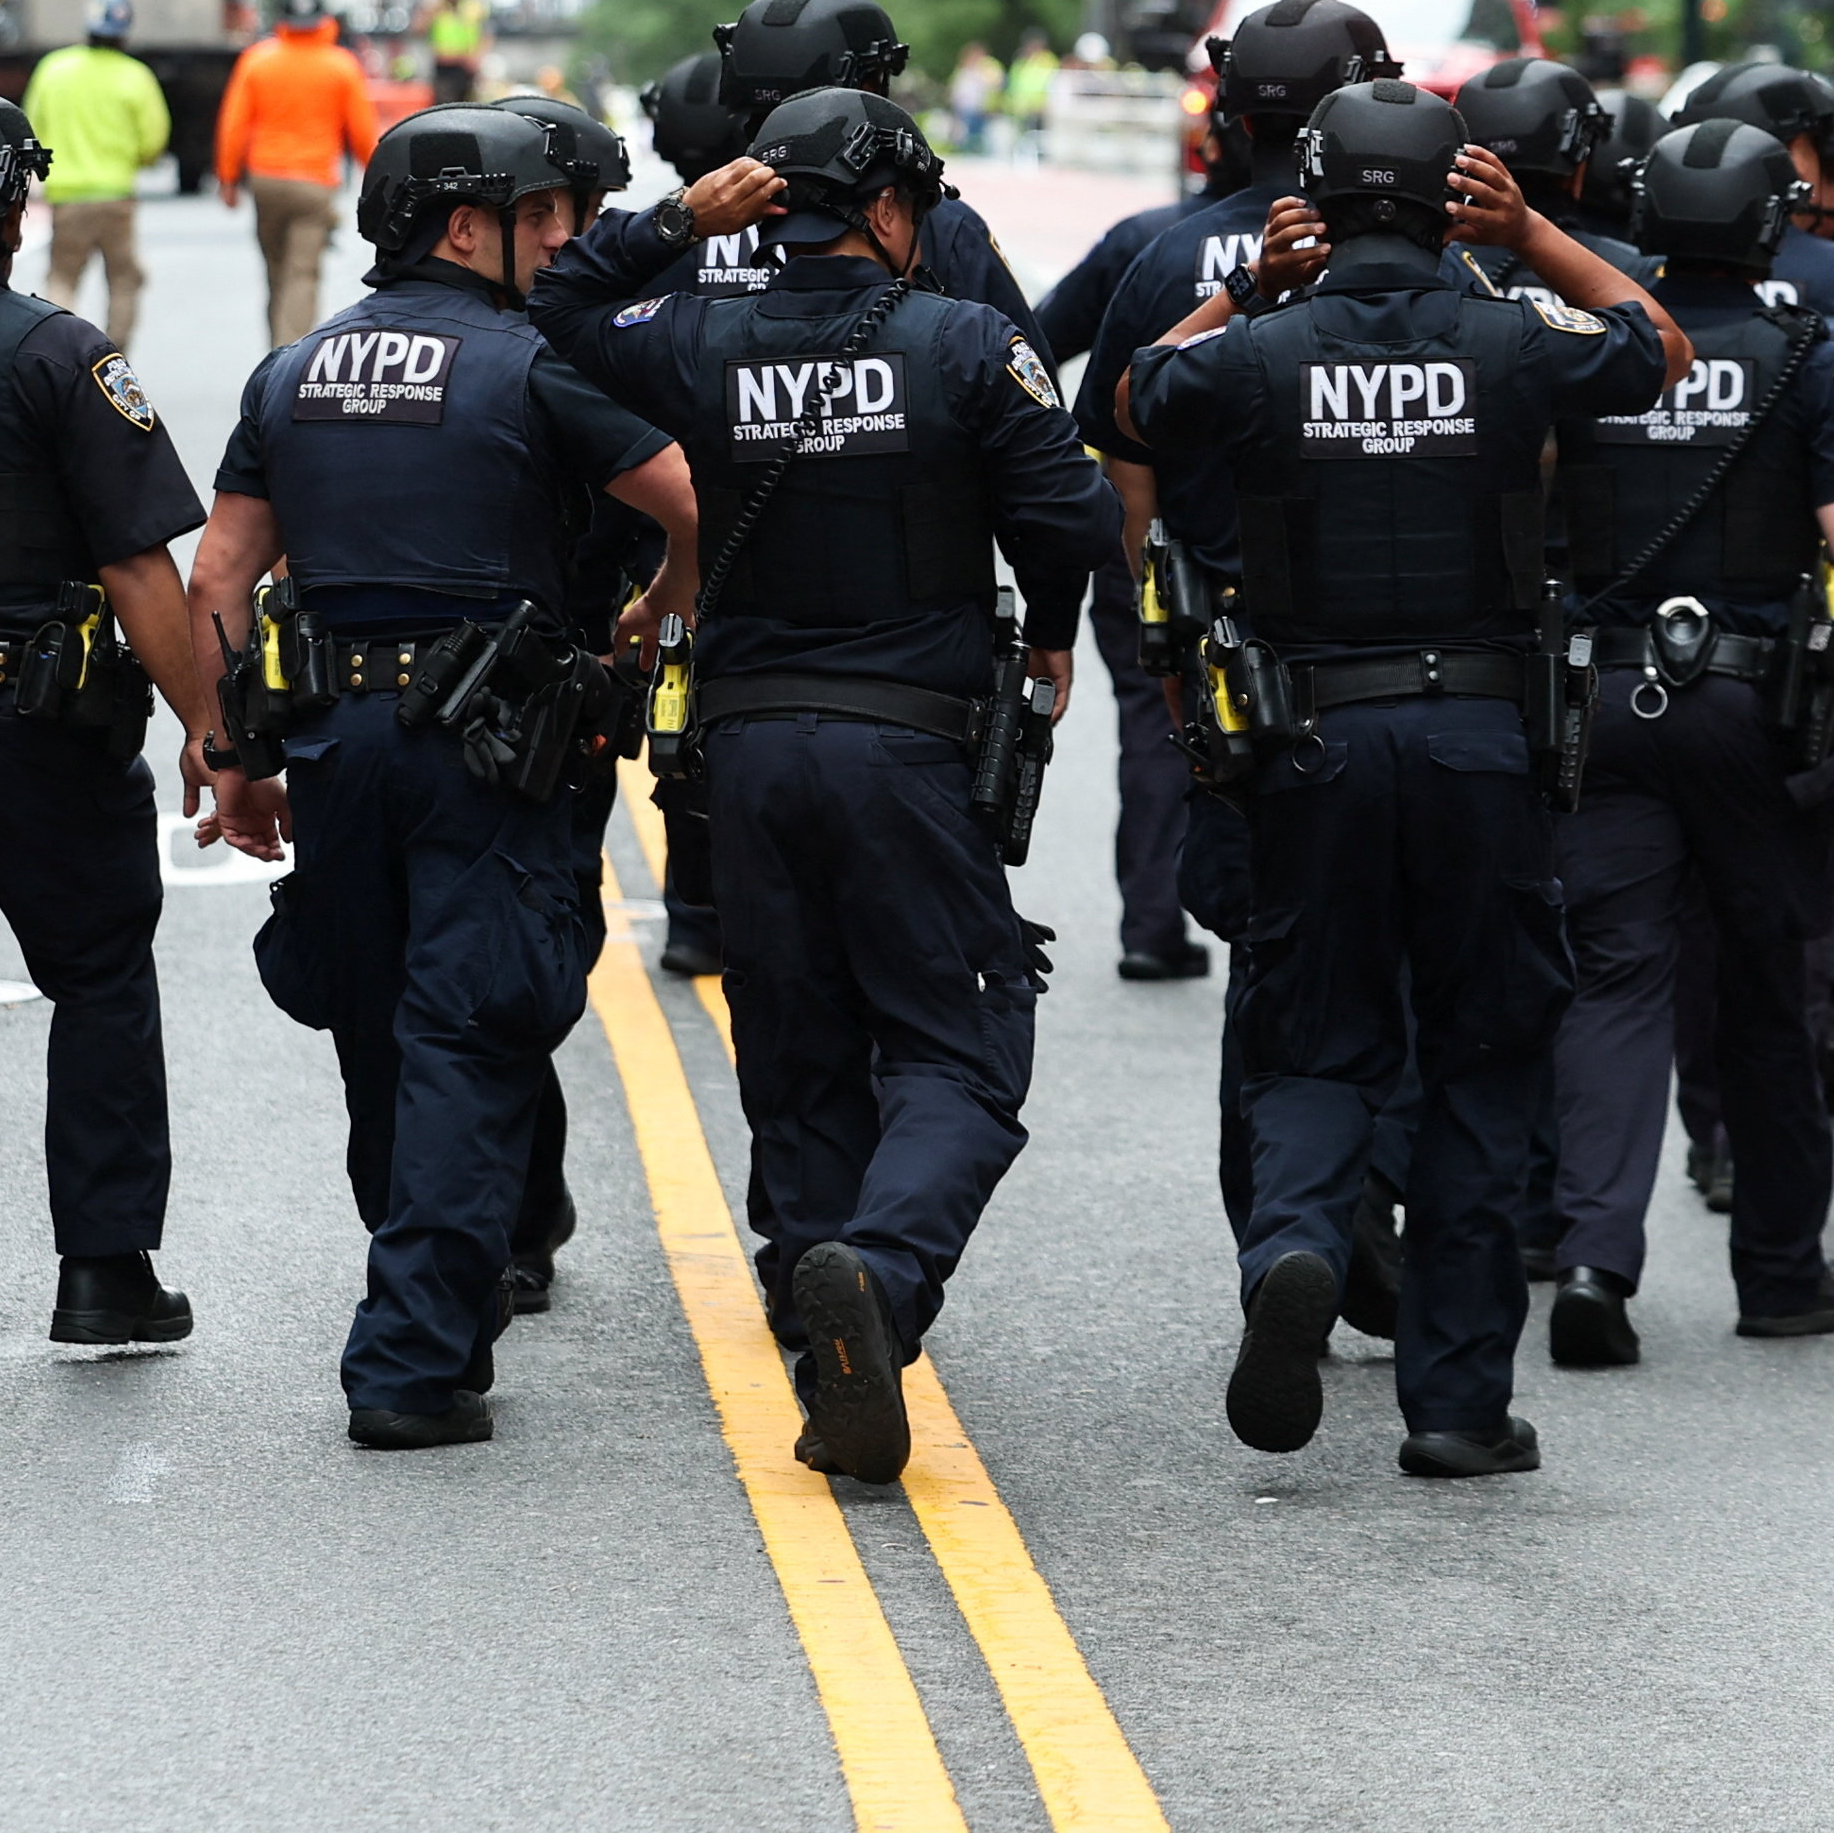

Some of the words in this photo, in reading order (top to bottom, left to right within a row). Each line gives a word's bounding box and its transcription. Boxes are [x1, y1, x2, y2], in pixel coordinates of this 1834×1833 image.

[754, 89, 781, 101] SRG
[1259, 85, 1286, 97] SRG
[762, 146, 787, 164] SRG
[1362, 170, 1395, 184] SRG
[443, 181, 458, 191] 342
[698, 268, 770, 284] STRATEGIC
[307, 332, 446, 383] NYPD
[298, 383, 366, 399] STRATEGIC
[370, 384, 443, 402] RESPONSE
[737, 358, 895, 423] NYPD
[1310, 362, 1466, 420] NYPD
[342, 398, 386, 414] GROUP
[822, 414, 905, 436] RESPONSE
[1303, 421, 1387, 438] STRATEGIC
[1392, 418, 1475, 438] RESPONSE
[1647, 425, 1695, 441] GROUP
[1362, 437, 1415, 454] GROUP
